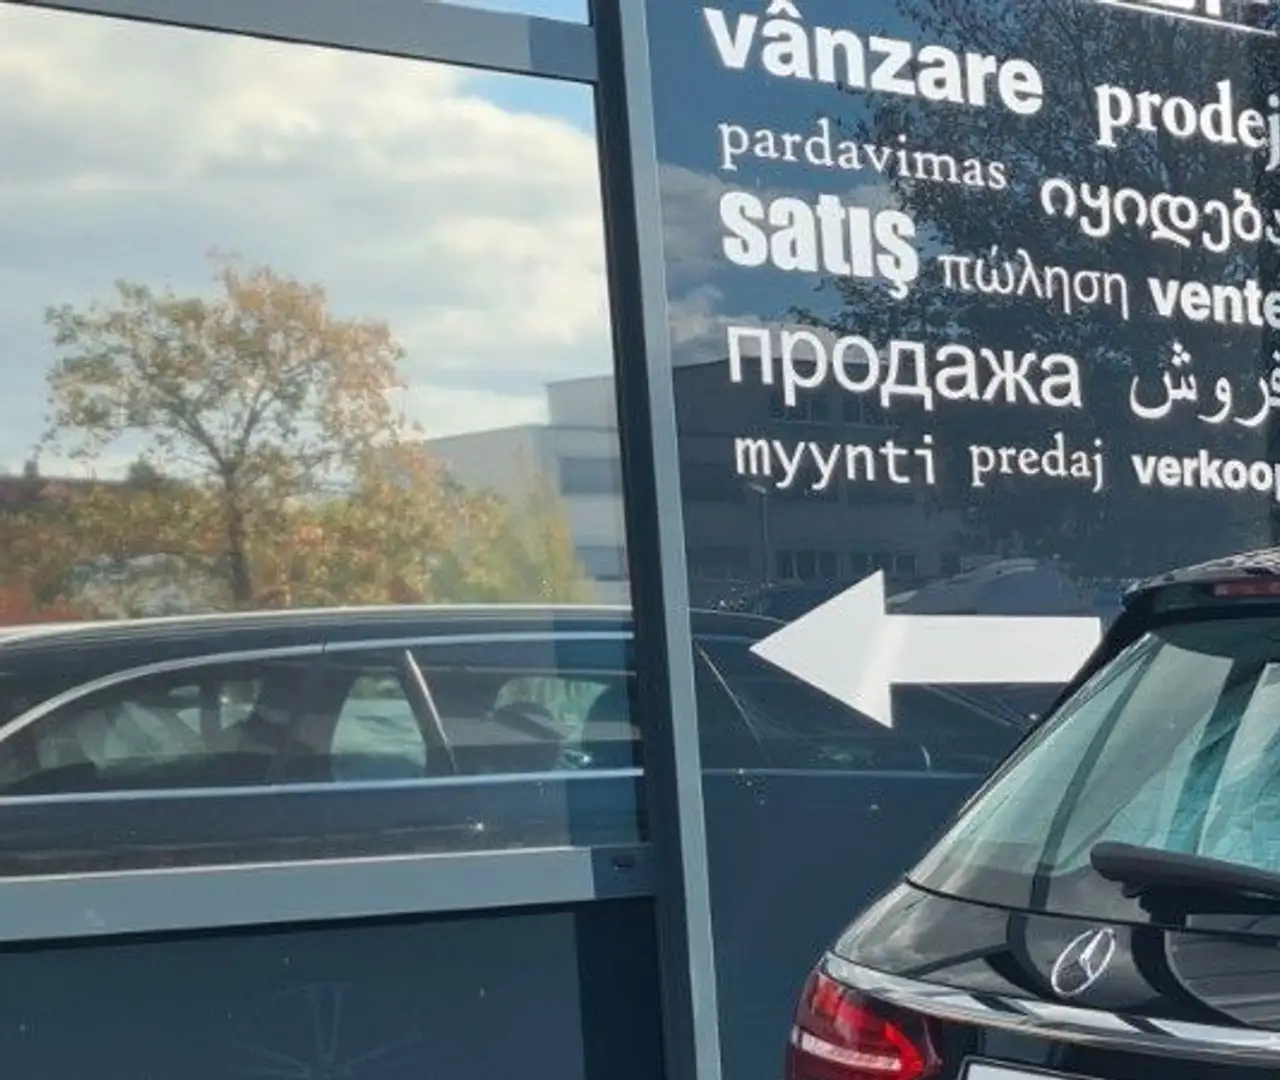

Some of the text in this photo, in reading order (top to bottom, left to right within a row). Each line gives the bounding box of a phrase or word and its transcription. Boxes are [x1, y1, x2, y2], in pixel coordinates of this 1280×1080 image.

[703, 0, 1280, 170] vânzare prodej
[719, 118, 1006, 189] pardavimas
[720, 192, 918, 299] satış
[938, 246, 1128, 317] πώληση
[727, 326, 1081, 410] продажа
[736, 435, 934, 489] myynti
[970, 432, 1102, 492] predaj
